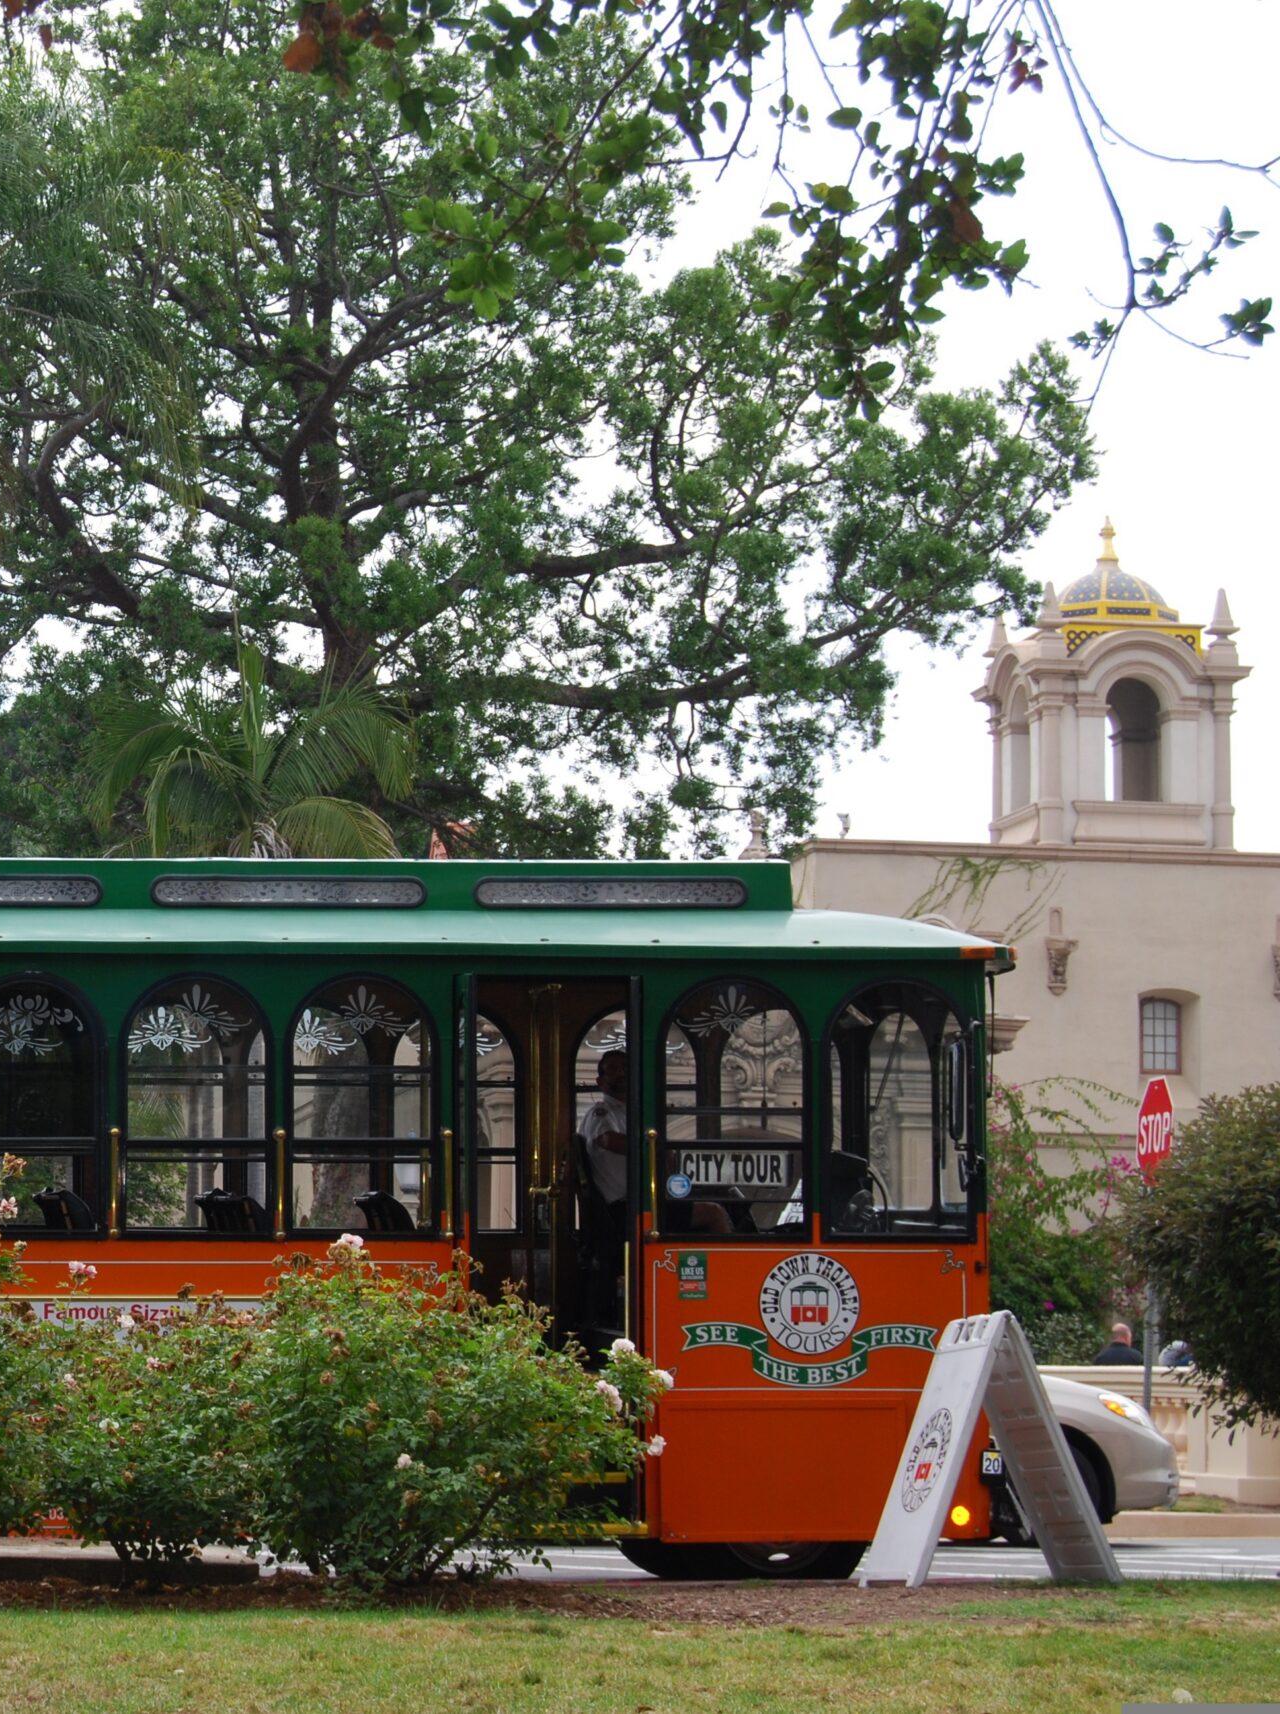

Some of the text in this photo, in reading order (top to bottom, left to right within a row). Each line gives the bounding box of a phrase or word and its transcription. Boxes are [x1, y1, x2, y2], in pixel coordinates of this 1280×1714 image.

[1139, 1112, 1171, 1155] STOP
[682, 1153, 782, 1183] CITY TOUR
[762, 1255, 858, 1315] OLD TOWN TROLLEY
[695, 1325, 739, 1342] SEE
[776, 1322, 846, 1352] TOURS
[870, 1327, 931, 1346] FIRST
[759, 1356, 862, 1384] THE BEST
[984, 1457, 1000, 1473] 20
